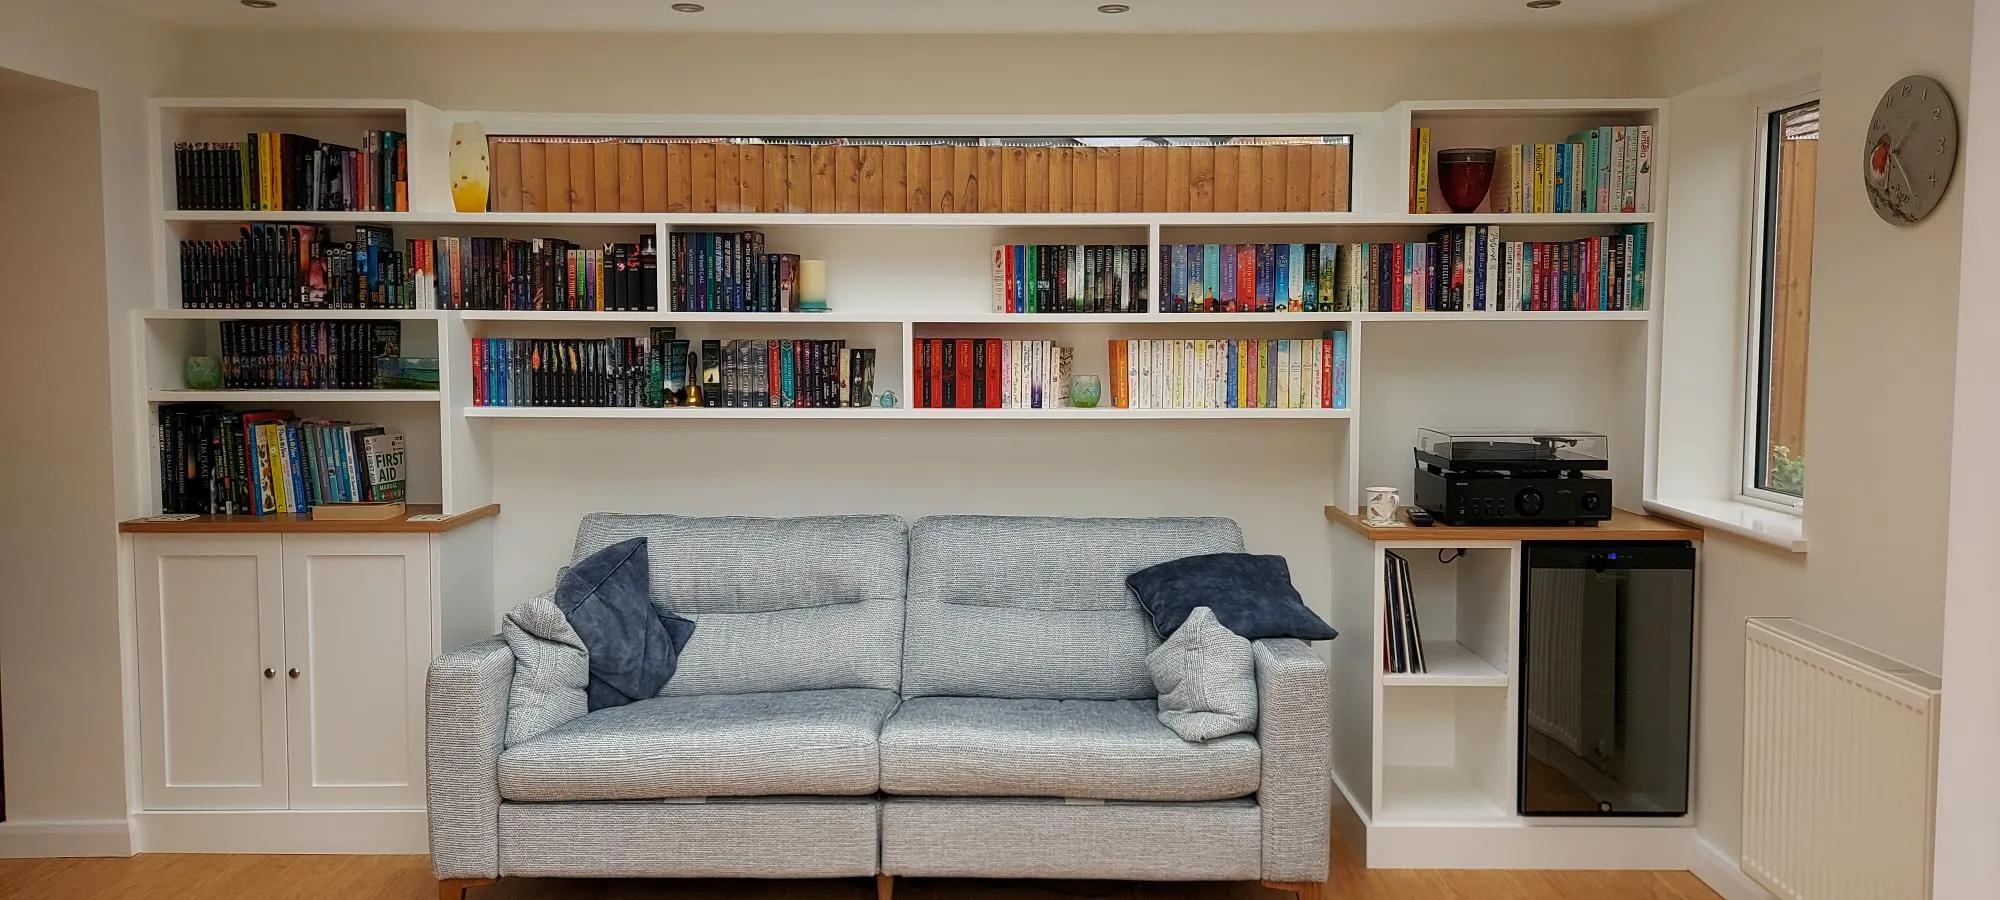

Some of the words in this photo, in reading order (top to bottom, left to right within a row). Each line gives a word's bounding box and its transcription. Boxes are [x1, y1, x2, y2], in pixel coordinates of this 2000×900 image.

[1901, 85, 1911, 97] 12
[1922, 90, 1927, 102] 1
[1886, 97, 1893, 108] 11
[1933, 109, 1942, 120] 2
[1640, 131, 1648, 158] kinsella
[1936, 137, 1946, 155] 3
[1929, 170, 1939, 187] 4
[376, 452, 403, 468] FIRST
[379, 467, 396, 482] AID
